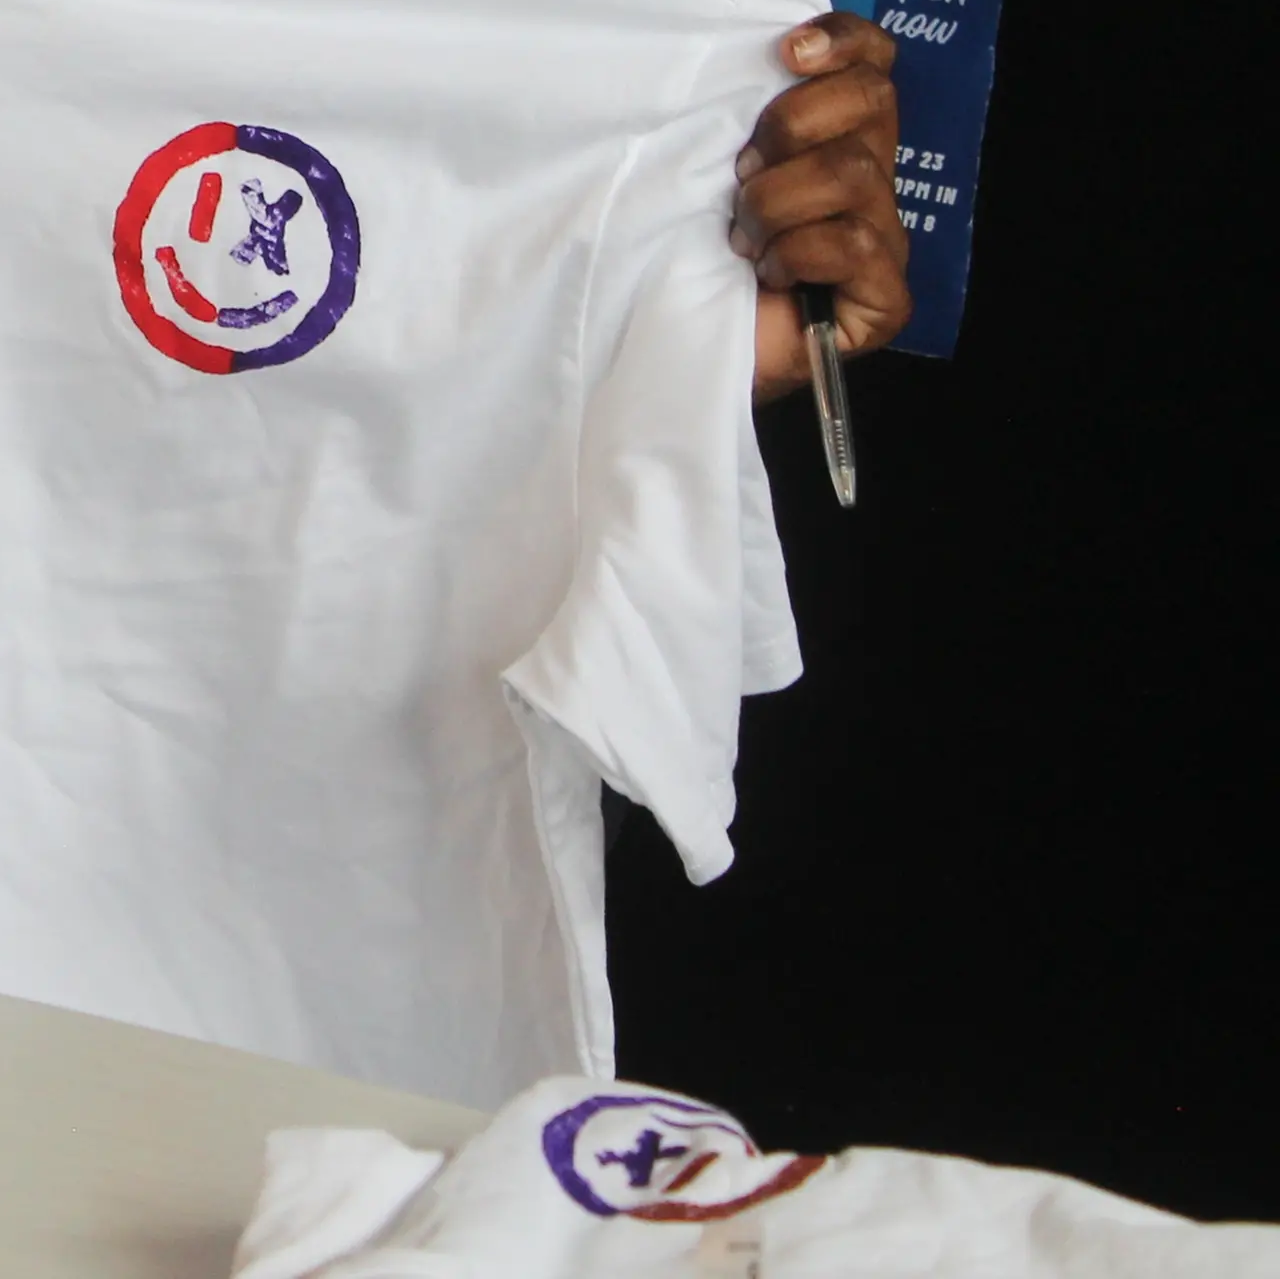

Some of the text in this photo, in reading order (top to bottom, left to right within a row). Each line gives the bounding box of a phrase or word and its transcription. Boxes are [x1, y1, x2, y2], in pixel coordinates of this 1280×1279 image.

[880, 9, 958, 44] now
[919, 150, 945, 171] 23
[935, 185, 958, 206] IN
